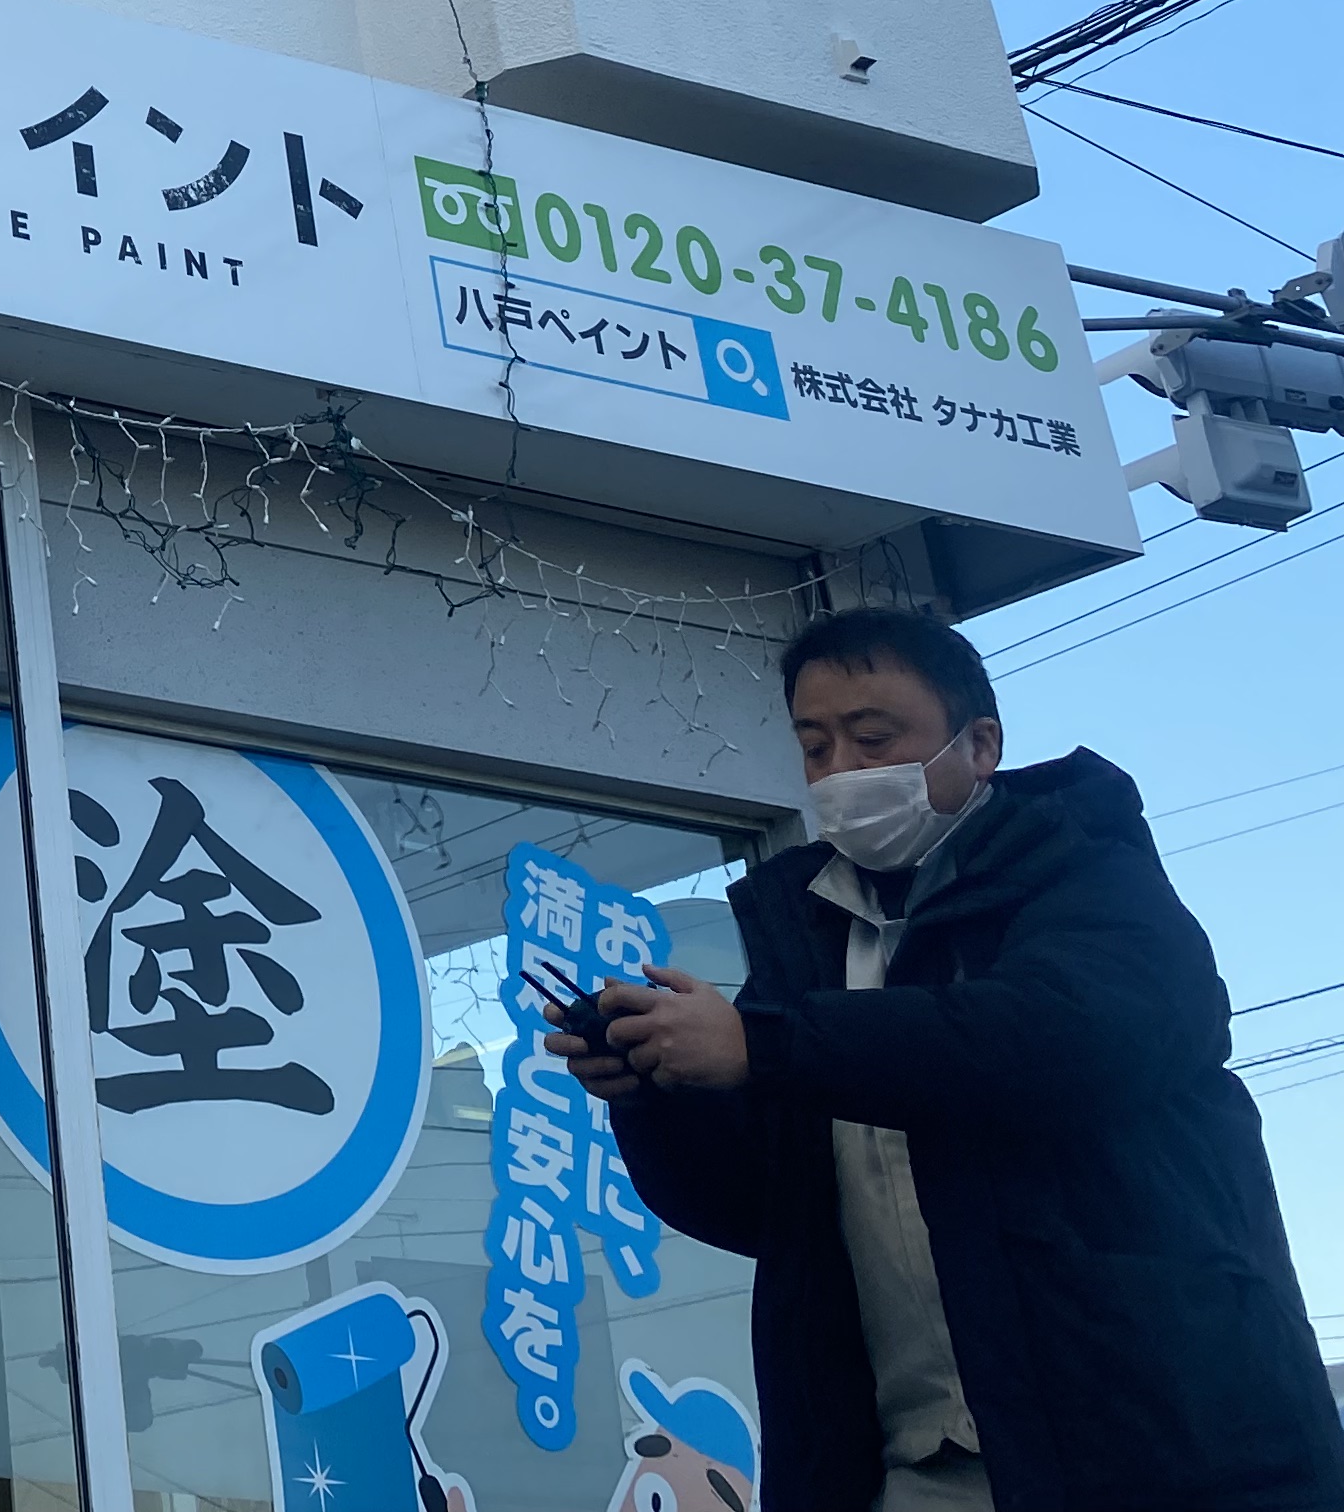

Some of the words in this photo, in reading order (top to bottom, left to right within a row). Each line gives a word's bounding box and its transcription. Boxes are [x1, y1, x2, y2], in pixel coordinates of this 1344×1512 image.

[82, 226, 244, 287] PAINT
[535, 192, 1058, 373] 0120-37-4186
[455, 285, 688, 371] 八戸ペイント
[790, 361, 923, 423] 株式会社
[932, 394, 1082, 457] タナカ工業
[68, 776, 336, 1116] 塗
